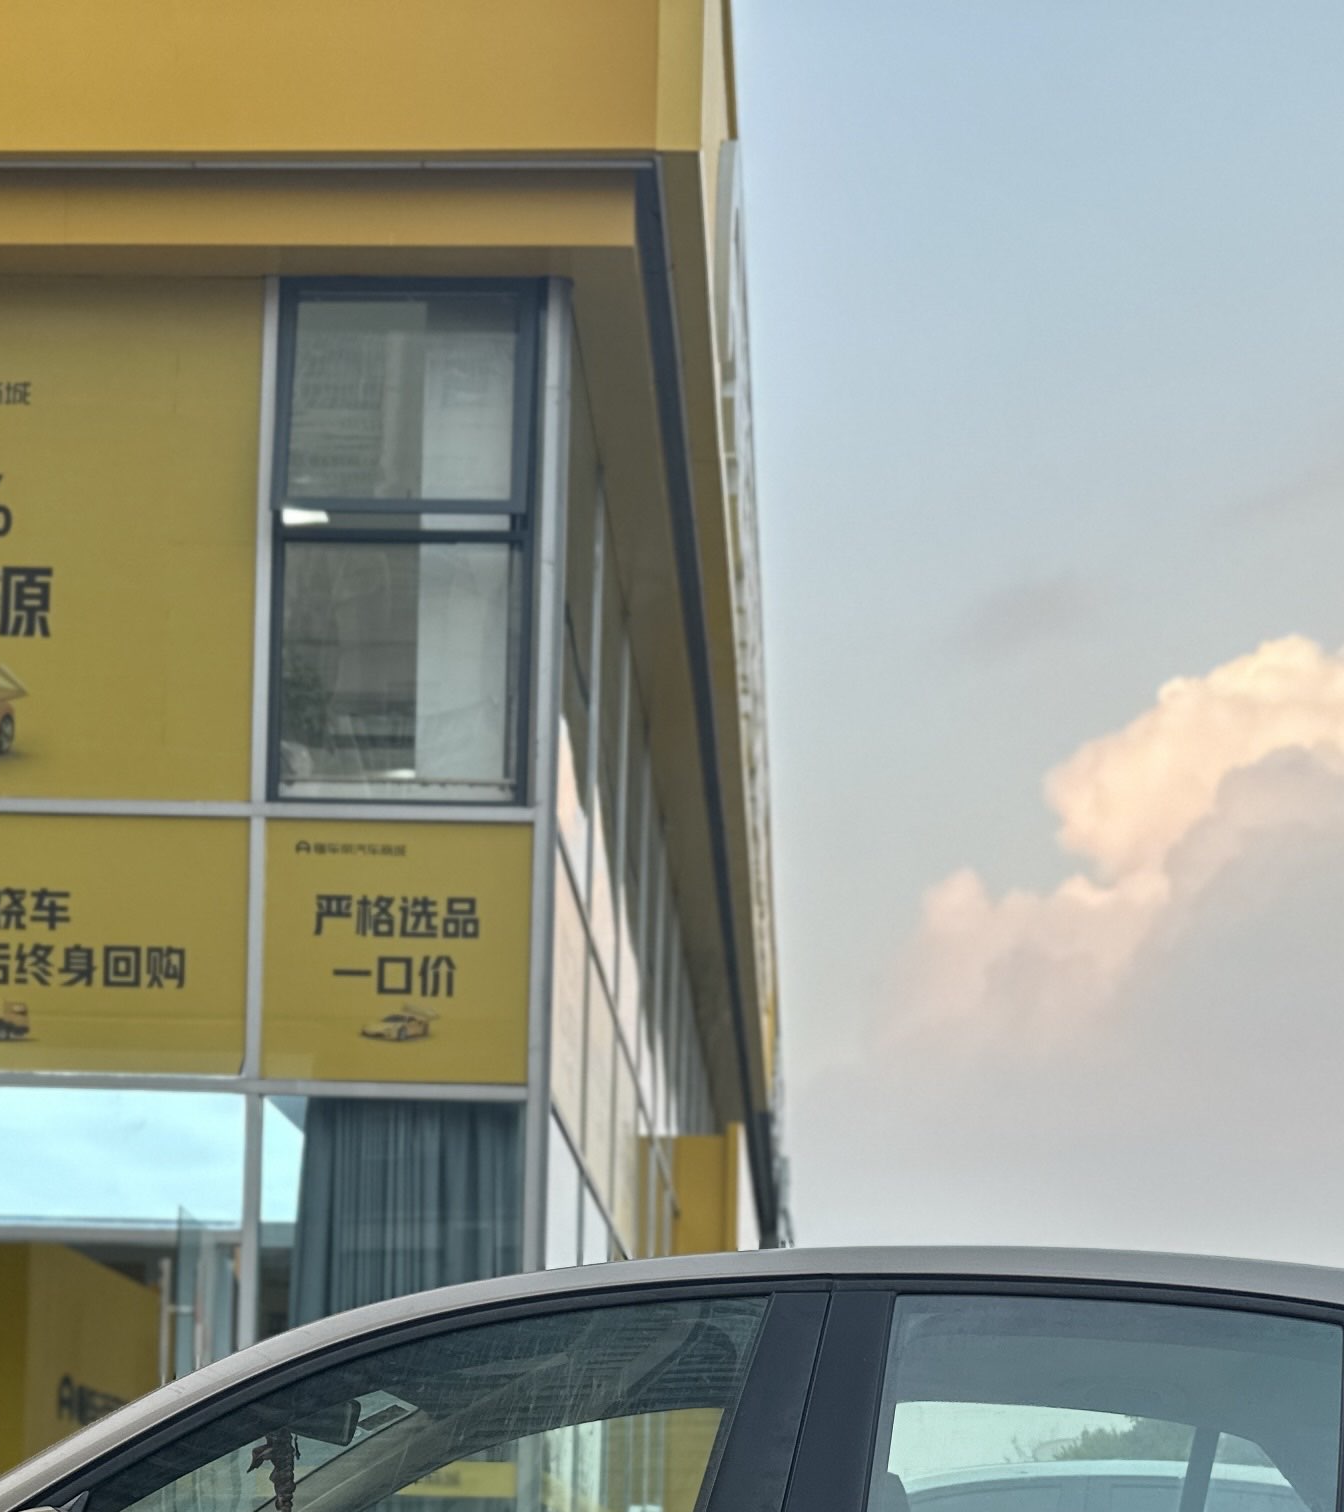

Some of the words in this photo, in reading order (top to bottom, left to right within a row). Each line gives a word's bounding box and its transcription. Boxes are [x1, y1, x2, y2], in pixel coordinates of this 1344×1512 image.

[313, 893, 480, 939] 严格选品
[332, 955, 457, 998] 一口价
